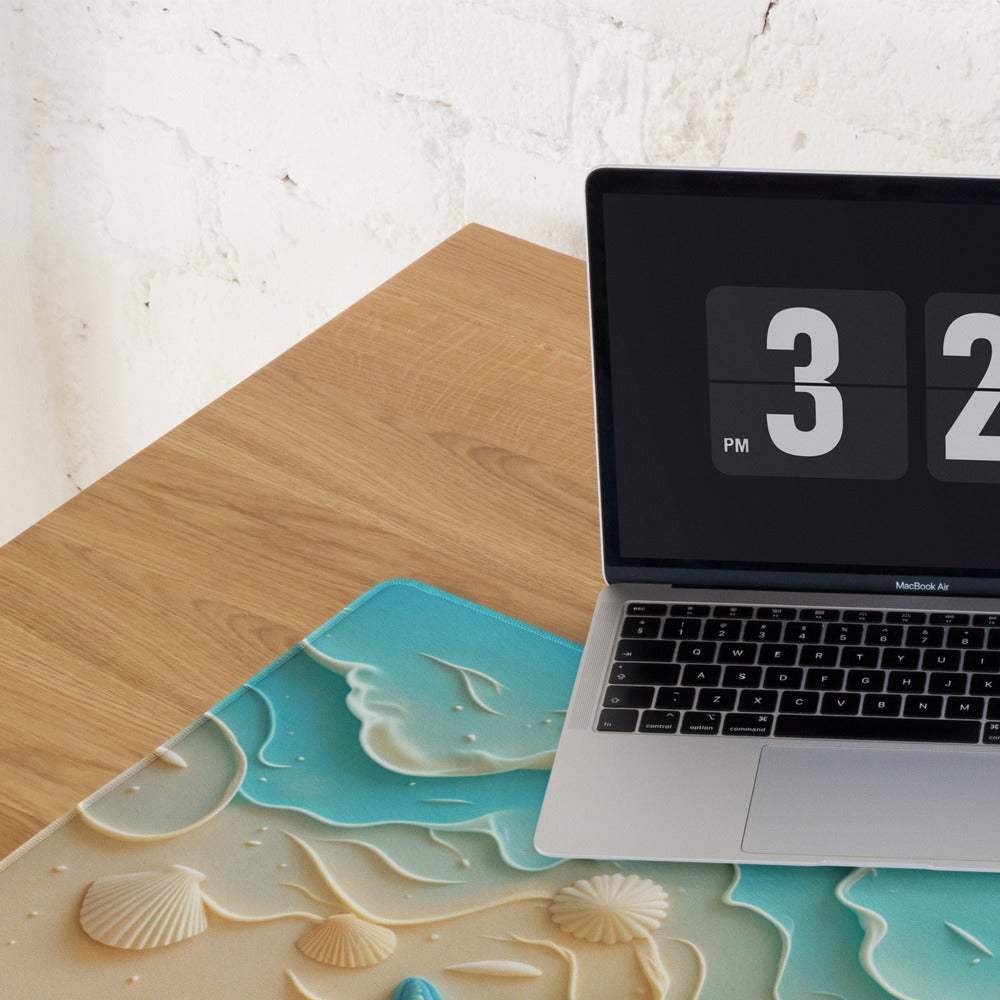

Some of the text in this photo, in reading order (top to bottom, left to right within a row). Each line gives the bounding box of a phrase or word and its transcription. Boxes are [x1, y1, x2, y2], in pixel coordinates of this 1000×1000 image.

[766, 307, 844, 457] 3
[723, 437, 749, 453] PM
[895, 581, 950, 591] MacBook Air
[689, 724, 714, 732] option
